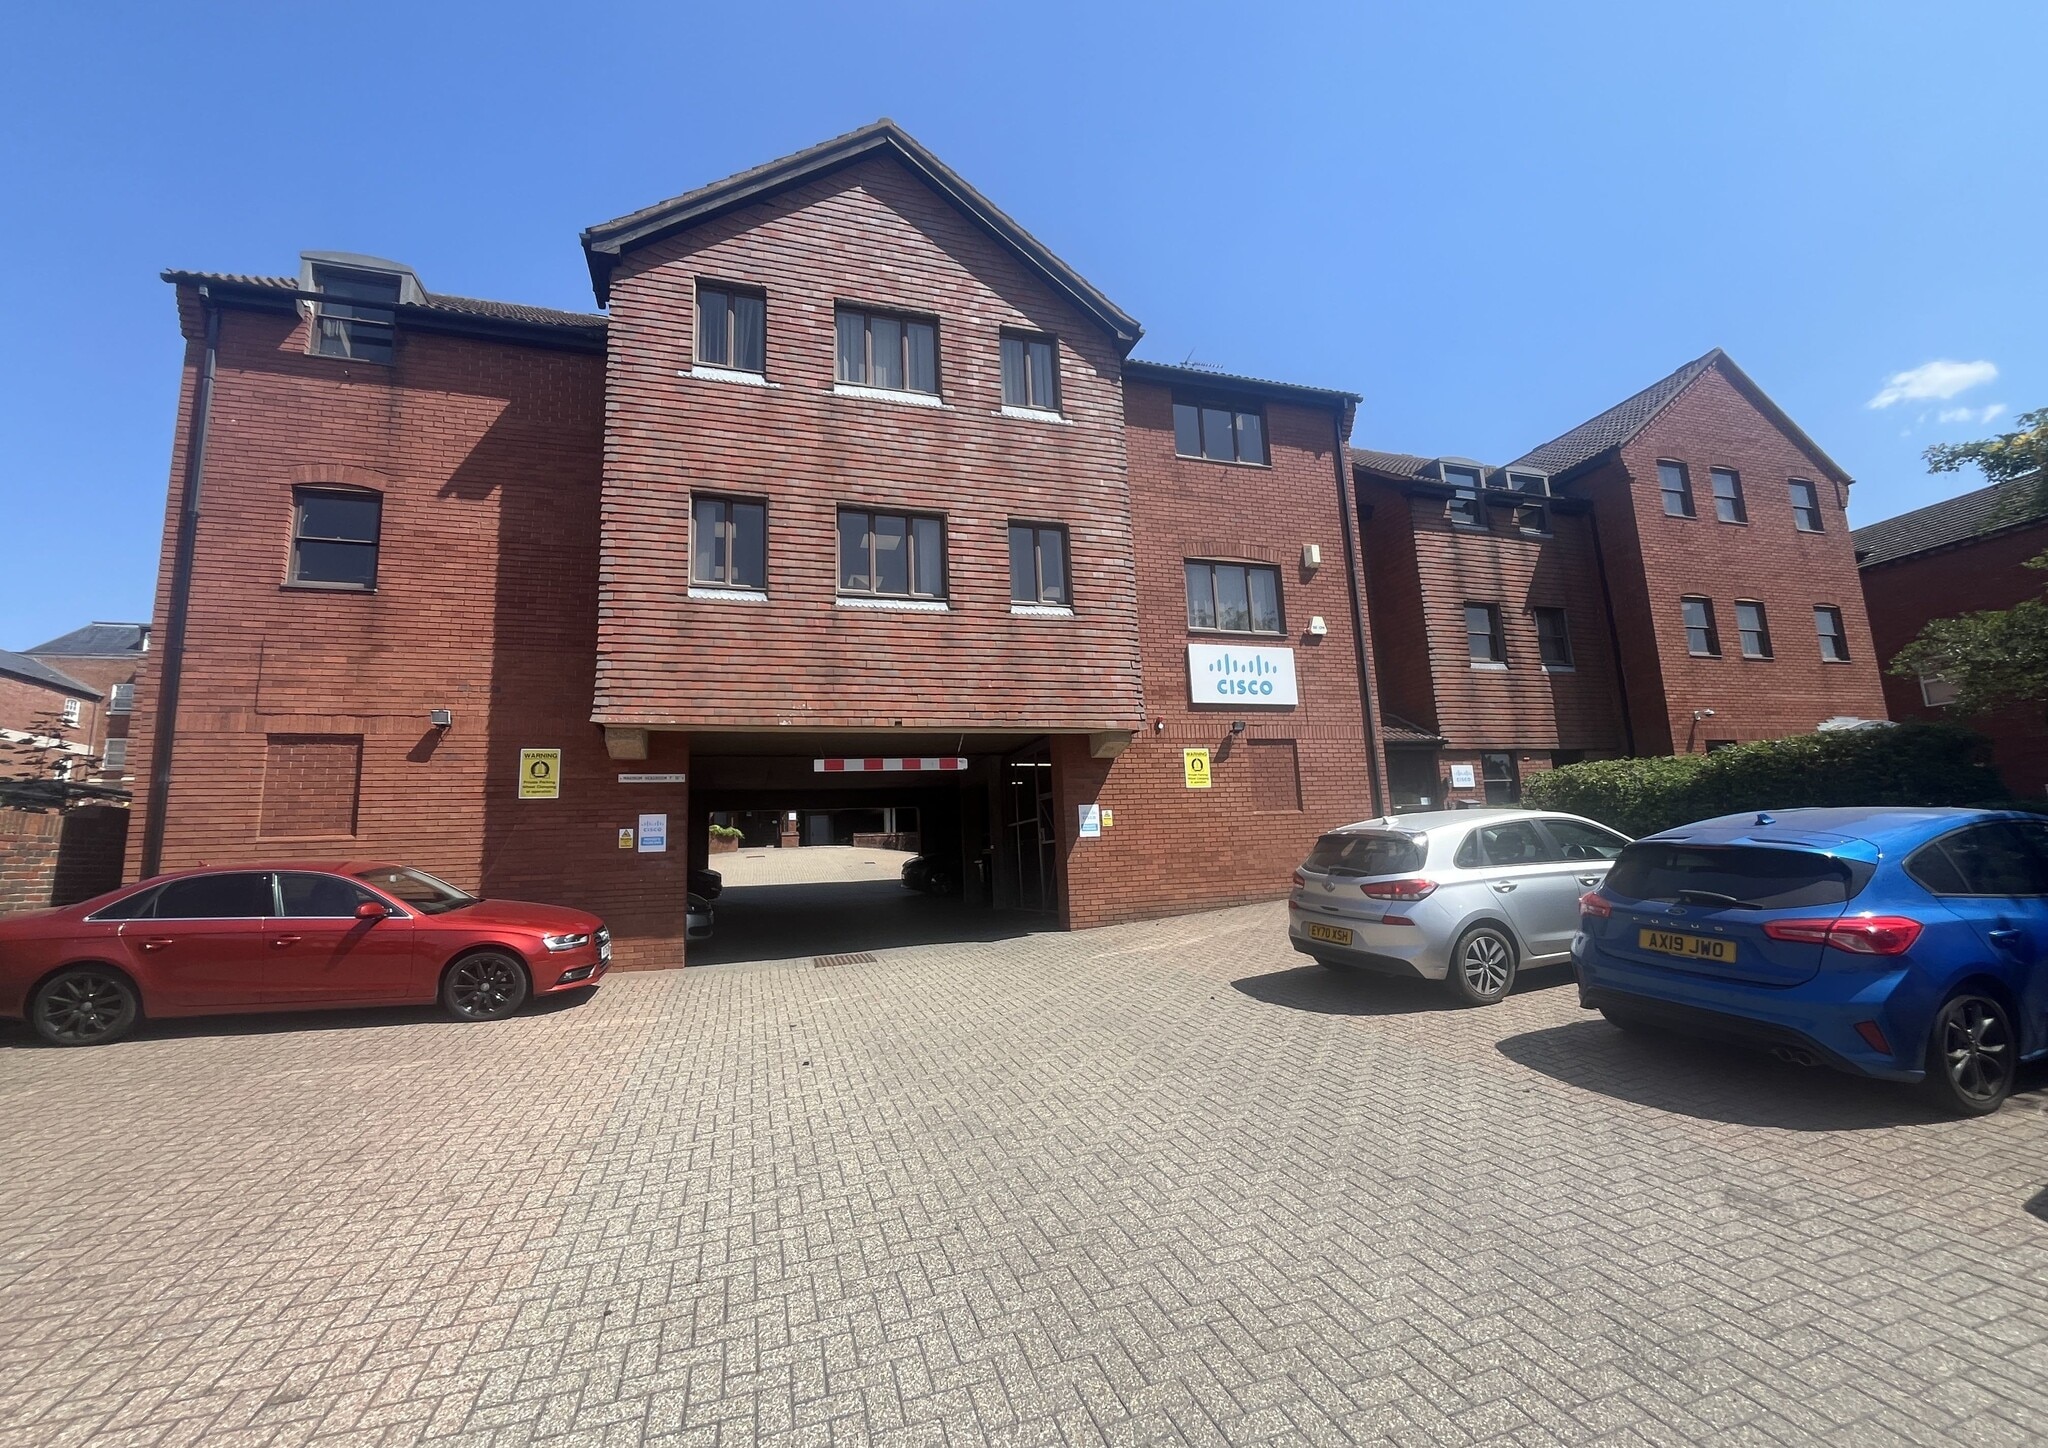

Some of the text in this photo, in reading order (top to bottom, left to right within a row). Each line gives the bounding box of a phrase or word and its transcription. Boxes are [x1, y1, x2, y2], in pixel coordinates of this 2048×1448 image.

[1217, 679, 1273, 696] CISCO
[1311, 925, 1348, 942] EY70 XSH
[1648, 932, 1724, 958] AX19 JWO
